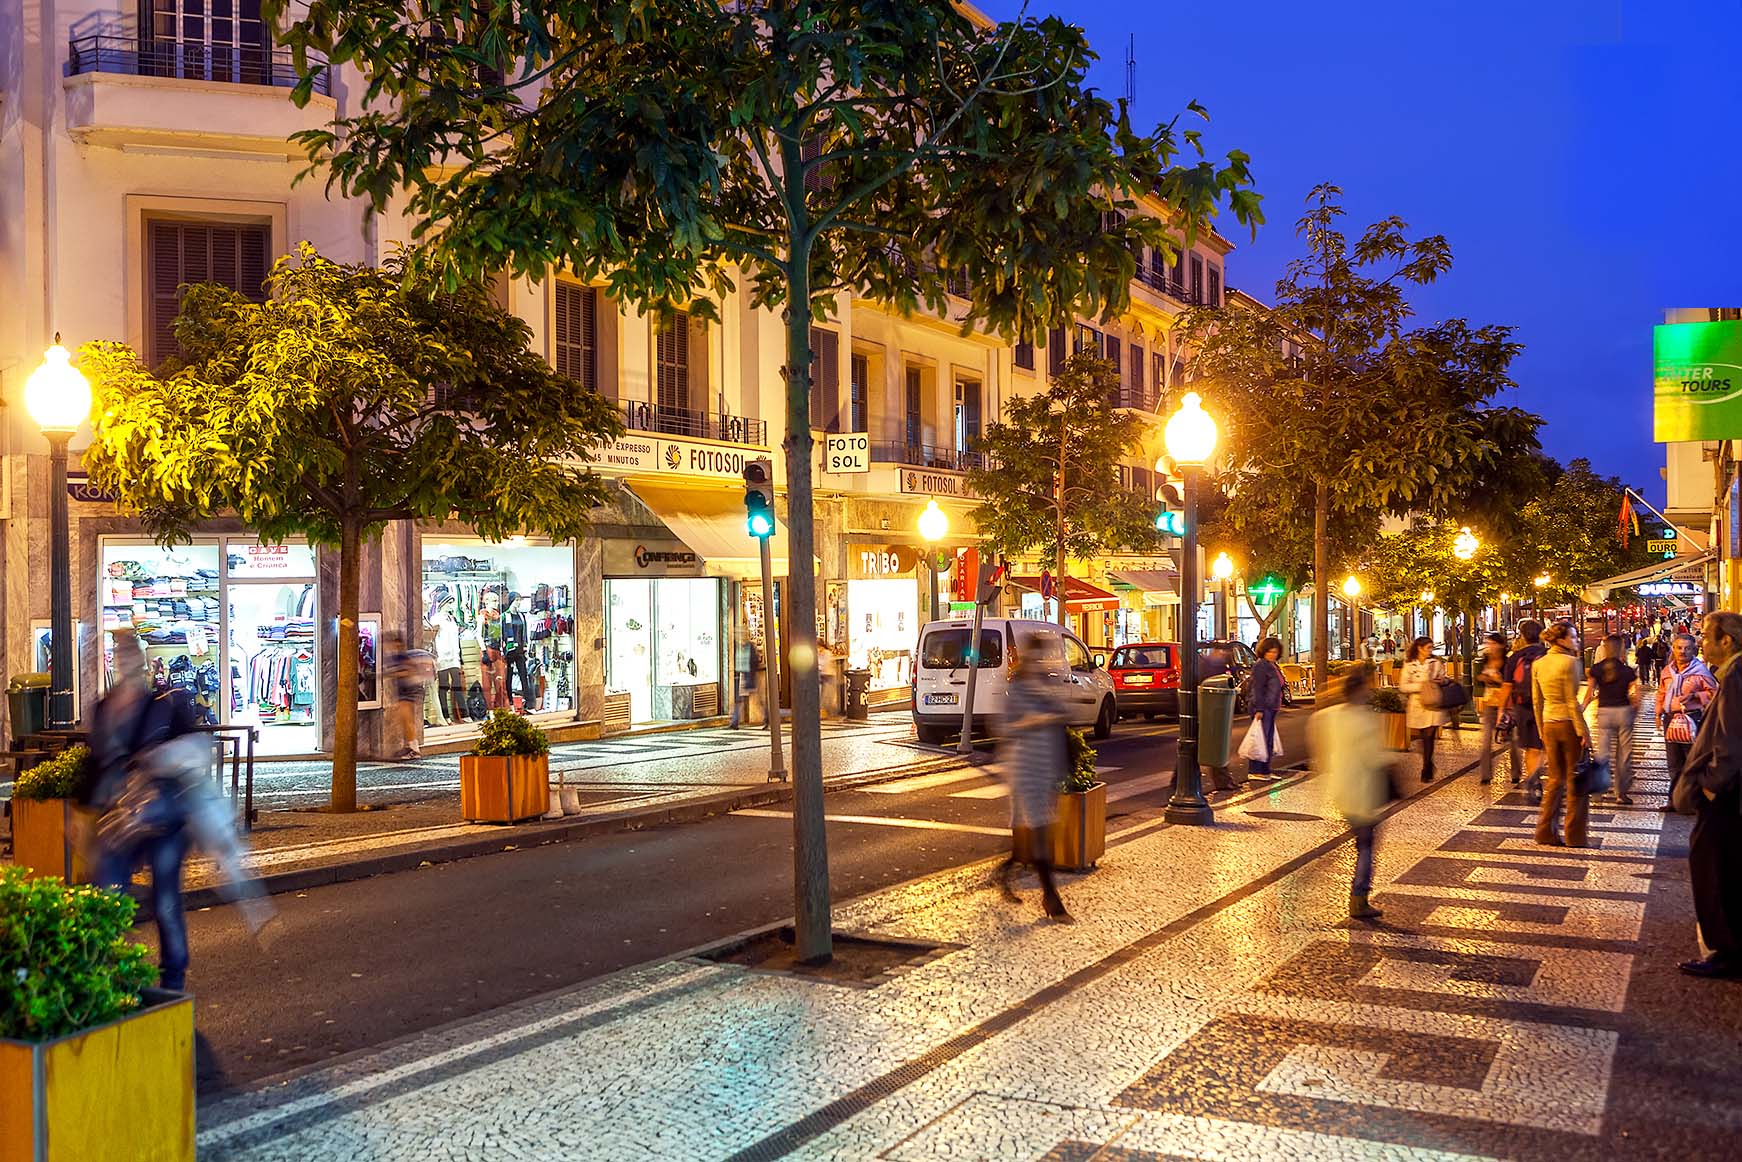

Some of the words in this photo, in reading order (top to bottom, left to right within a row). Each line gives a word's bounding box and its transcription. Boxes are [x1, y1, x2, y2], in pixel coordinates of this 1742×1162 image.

[1681, 379, 1731, 392] TOURS
[615, 442, 651, 454] EXPRESSO
[607, 454, 639, 465] MINUTOS
[832, 456, 861, 468] SOL
[922, 475, 958, 494] FOTOSOL
[1650, 543, 1677, 552] OURO
[861, 550, 899, 575] TRIBO
